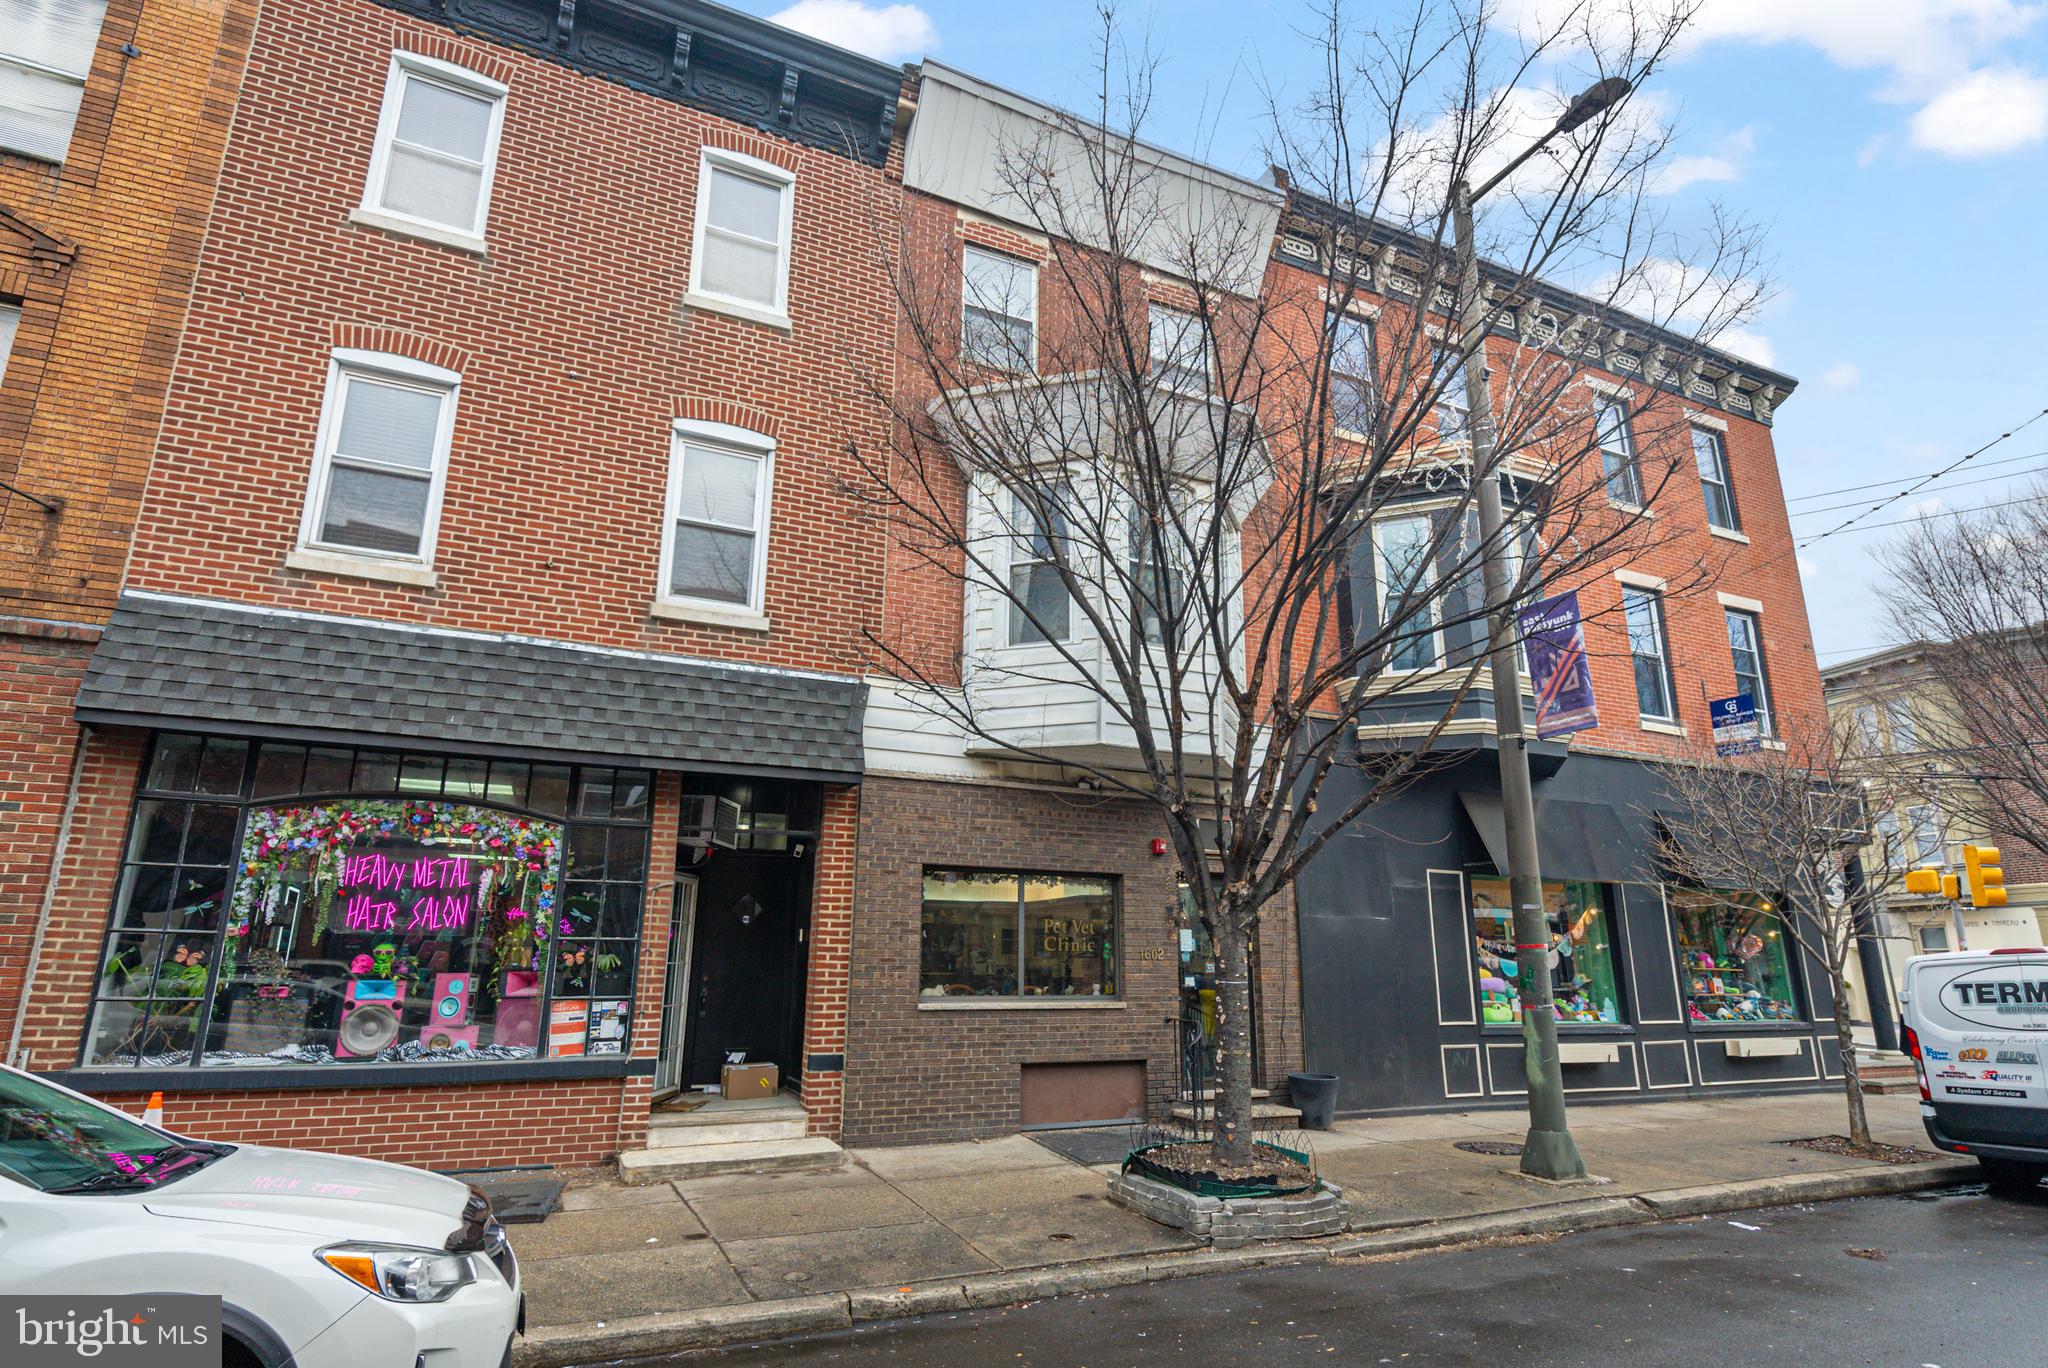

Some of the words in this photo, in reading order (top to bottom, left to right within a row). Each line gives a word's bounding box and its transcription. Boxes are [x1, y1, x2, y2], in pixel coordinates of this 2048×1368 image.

[344, 853, 406, 891] HEAVY
[412, 856, 472, 889] METAL
[345, 894, 398, 931] HAIR
[408, 895, 470, 931] SALON
[1043, 919, 1067, 934] Pet
[1072, 919, 1096, 934] Vet
[1043, 936, 1095, 952] Clinic
[1140, 948, 1164, 960] 1602
[1953, 981, 2048, 1004] TERM
[1957, 1087, 1982, 1095] System
